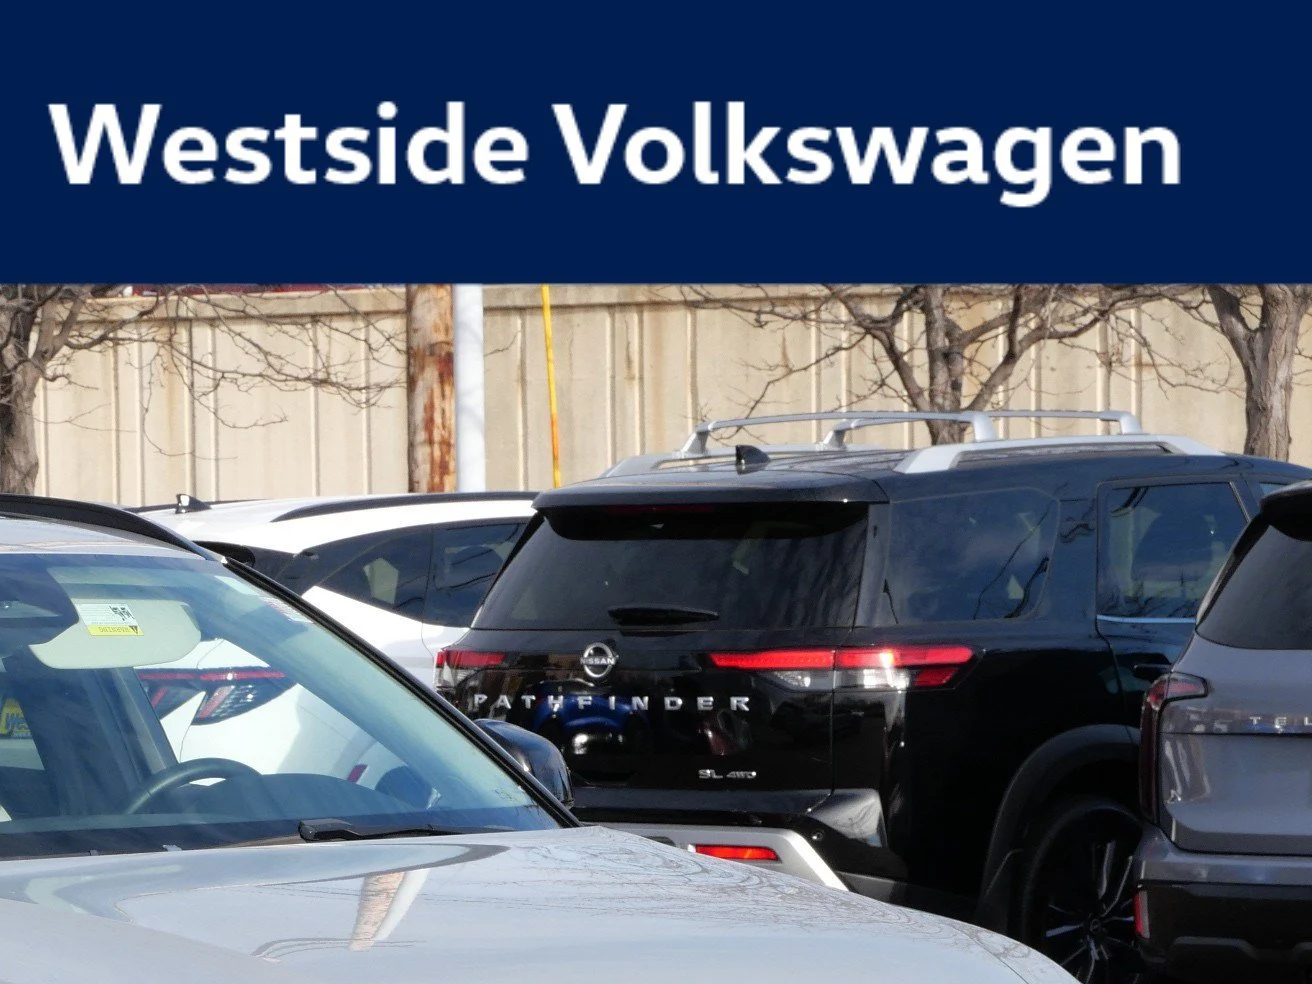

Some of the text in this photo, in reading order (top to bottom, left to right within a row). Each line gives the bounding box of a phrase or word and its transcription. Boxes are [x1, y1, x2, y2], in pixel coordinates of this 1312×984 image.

[580, 657, 615, 665] NISSAN
[473, 693, 750, 712] PATHFINDER
[698, 768, 757, 779] SL 4WD
